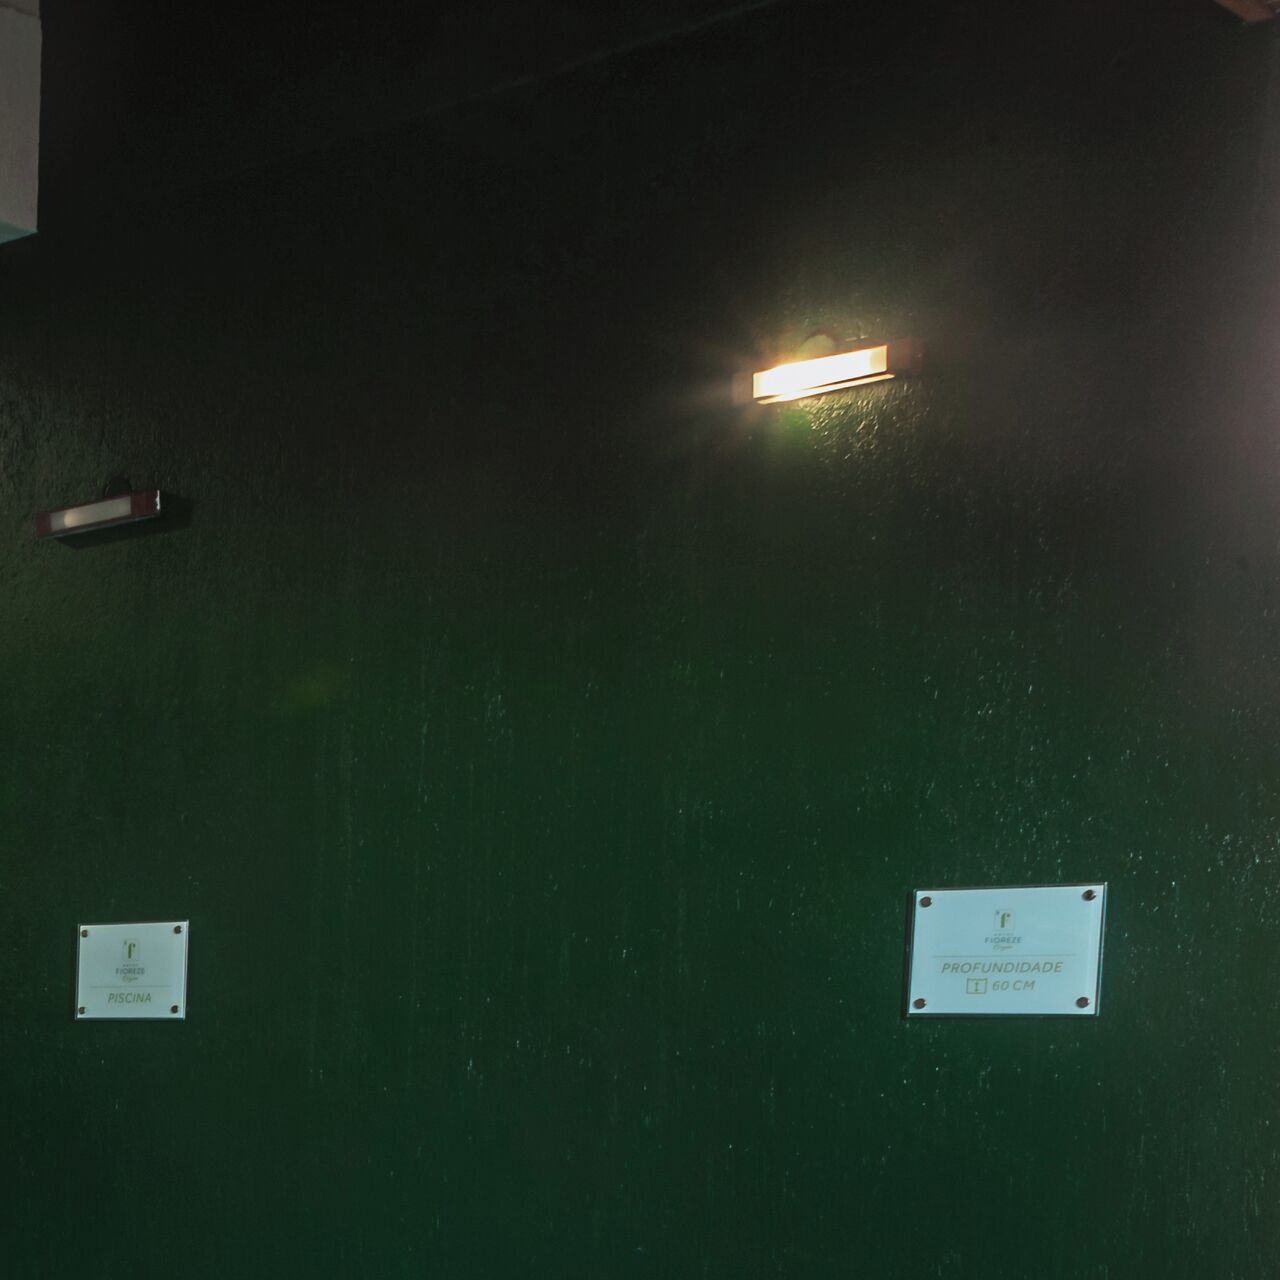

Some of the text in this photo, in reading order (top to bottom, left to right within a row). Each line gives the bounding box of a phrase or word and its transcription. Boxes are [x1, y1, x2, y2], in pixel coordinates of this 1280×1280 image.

[984, 936, 1024, 944] FIOREZE
[942, 961, 1064, 974] PROFUNDIDADE
[992, 980, 1036, 991] 60 CM
[107, 992, 152, 1004] PISCINA
